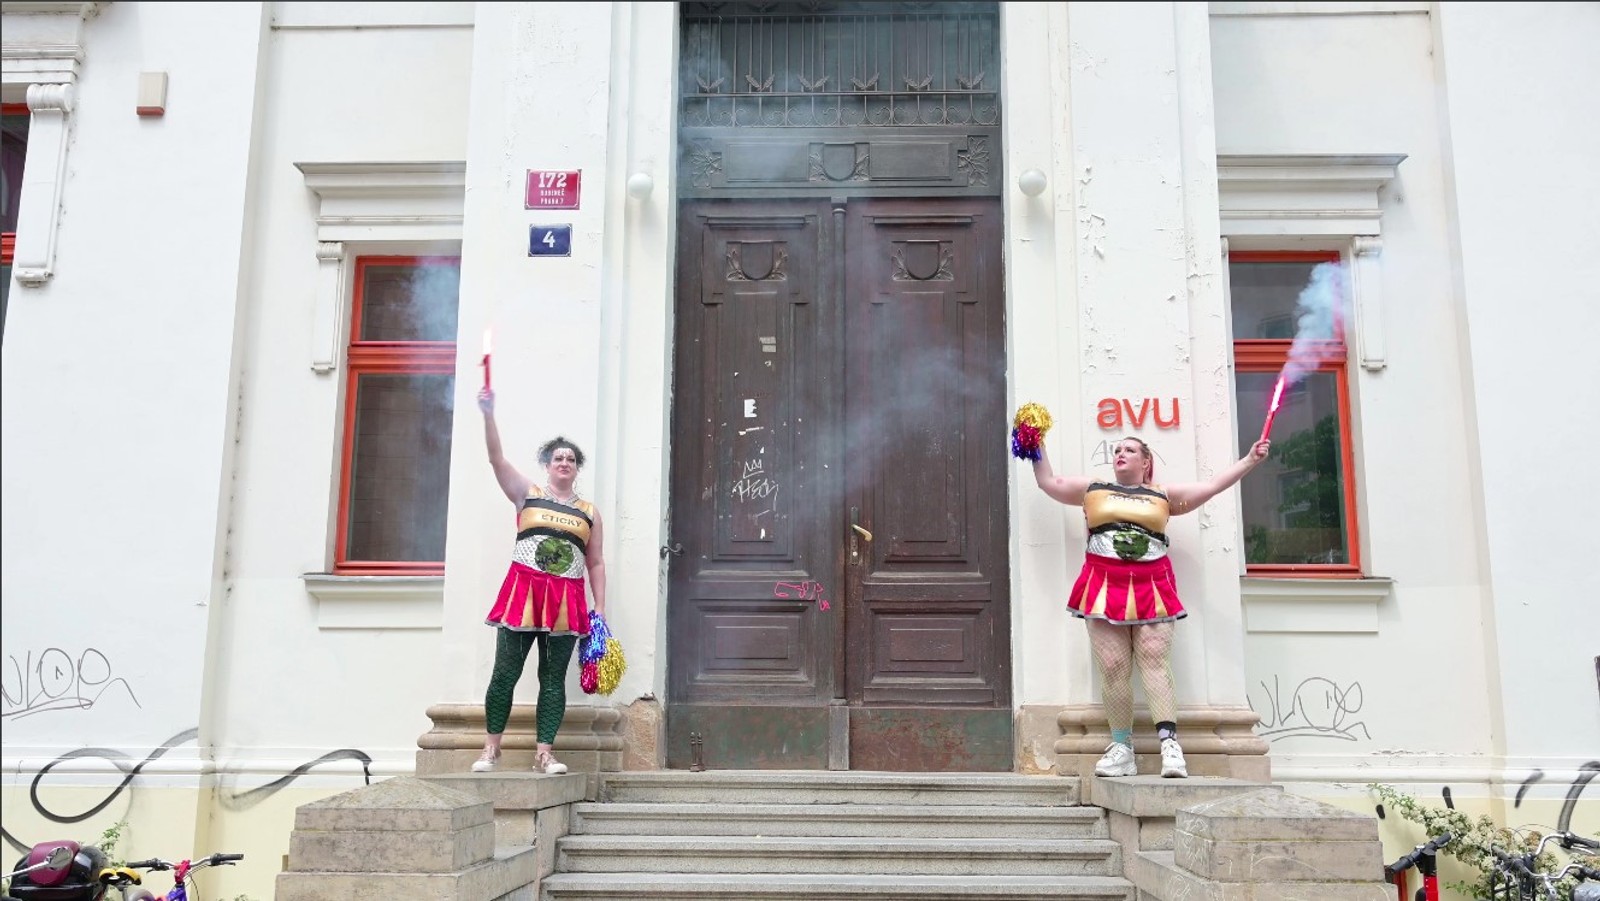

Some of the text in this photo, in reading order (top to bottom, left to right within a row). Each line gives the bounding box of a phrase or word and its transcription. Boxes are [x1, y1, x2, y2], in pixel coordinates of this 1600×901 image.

[538, 172, 567, 188] 172
[542, 231, 556, 248] 4
[1097, 397, 1180, 428] avu
